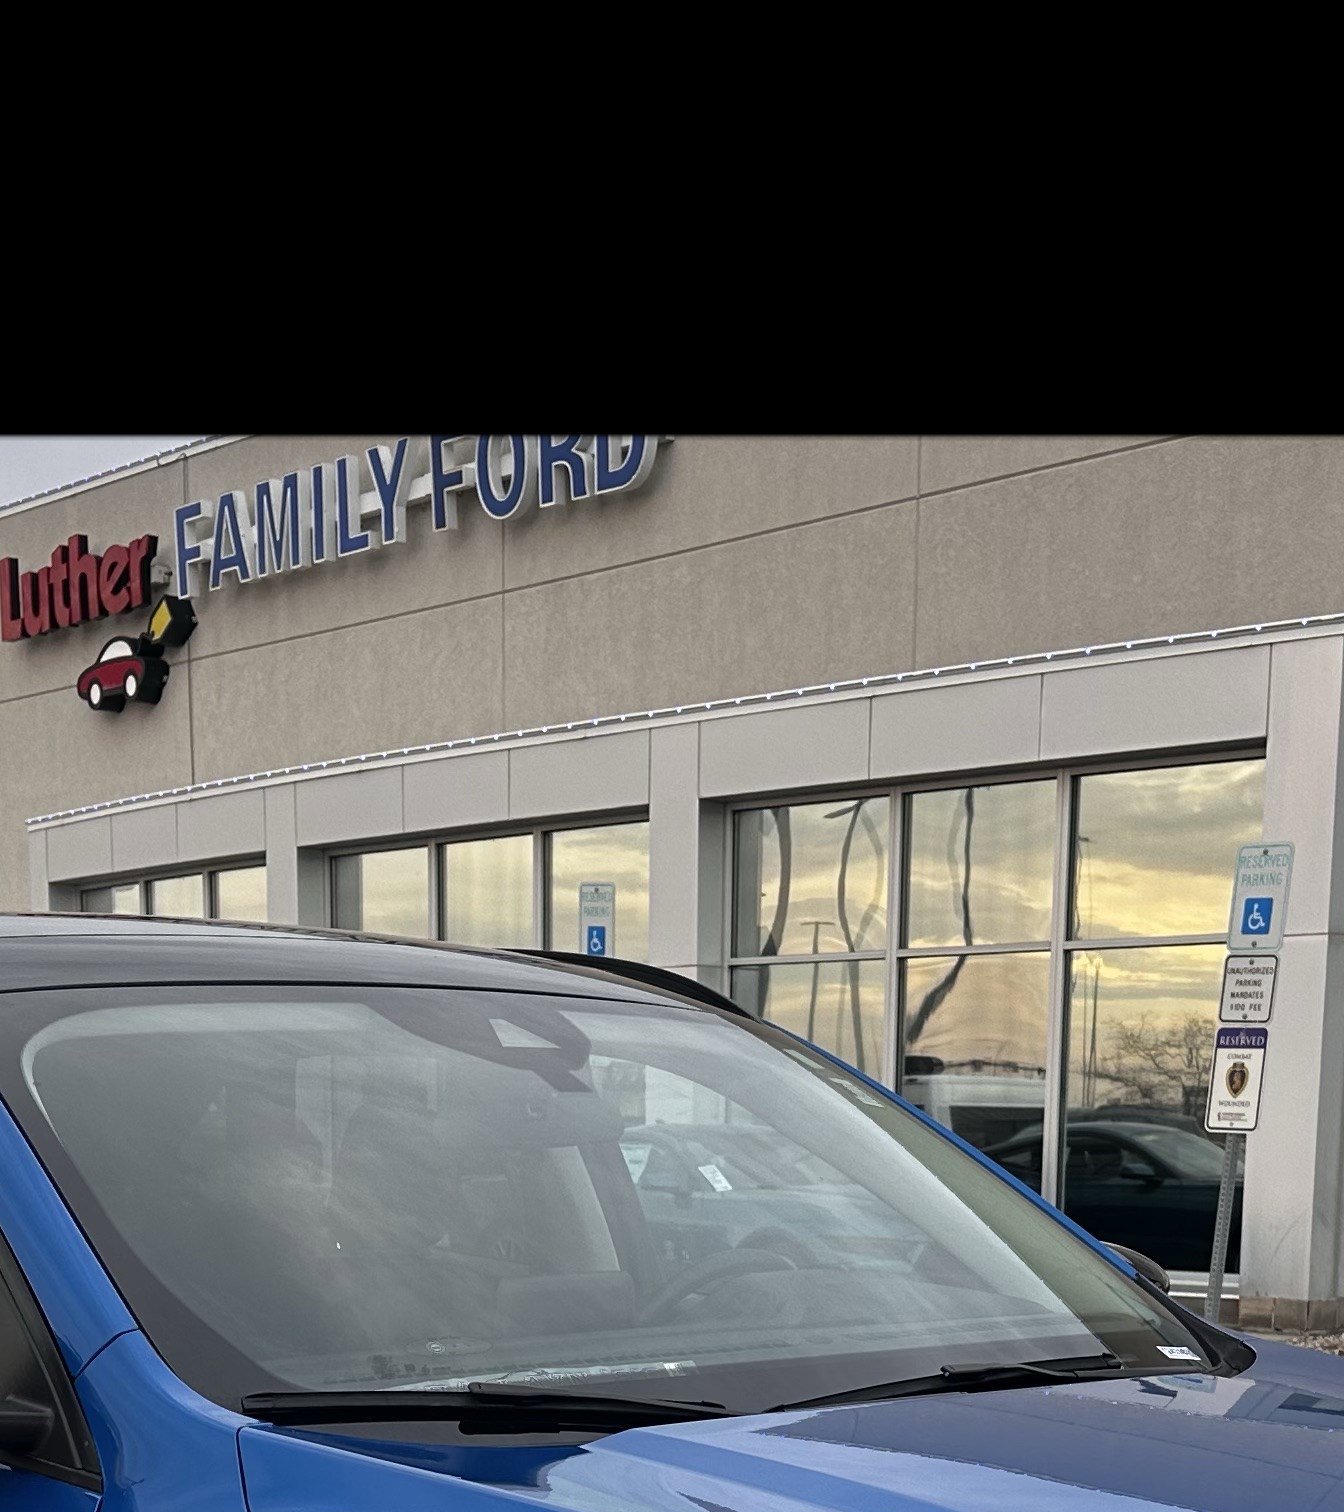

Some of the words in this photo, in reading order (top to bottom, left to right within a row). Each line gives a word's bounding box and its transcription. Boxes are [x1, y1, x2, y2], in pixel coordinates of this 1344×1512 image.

[173, 436, 411, 600] FAMILY
[430, 435, 658, 531] FORD
[1238, 853, 1290, 869] RESERVED
[1241, 872, 1284, 888] PARKING
[1235, 979, 1263, 987] PARKING
[1230, 991, 1264, 999] MANDATES
[1248, 1003, 1262, 1011] FEE
[1219, 1035, 1265, 1046] RESERVED
